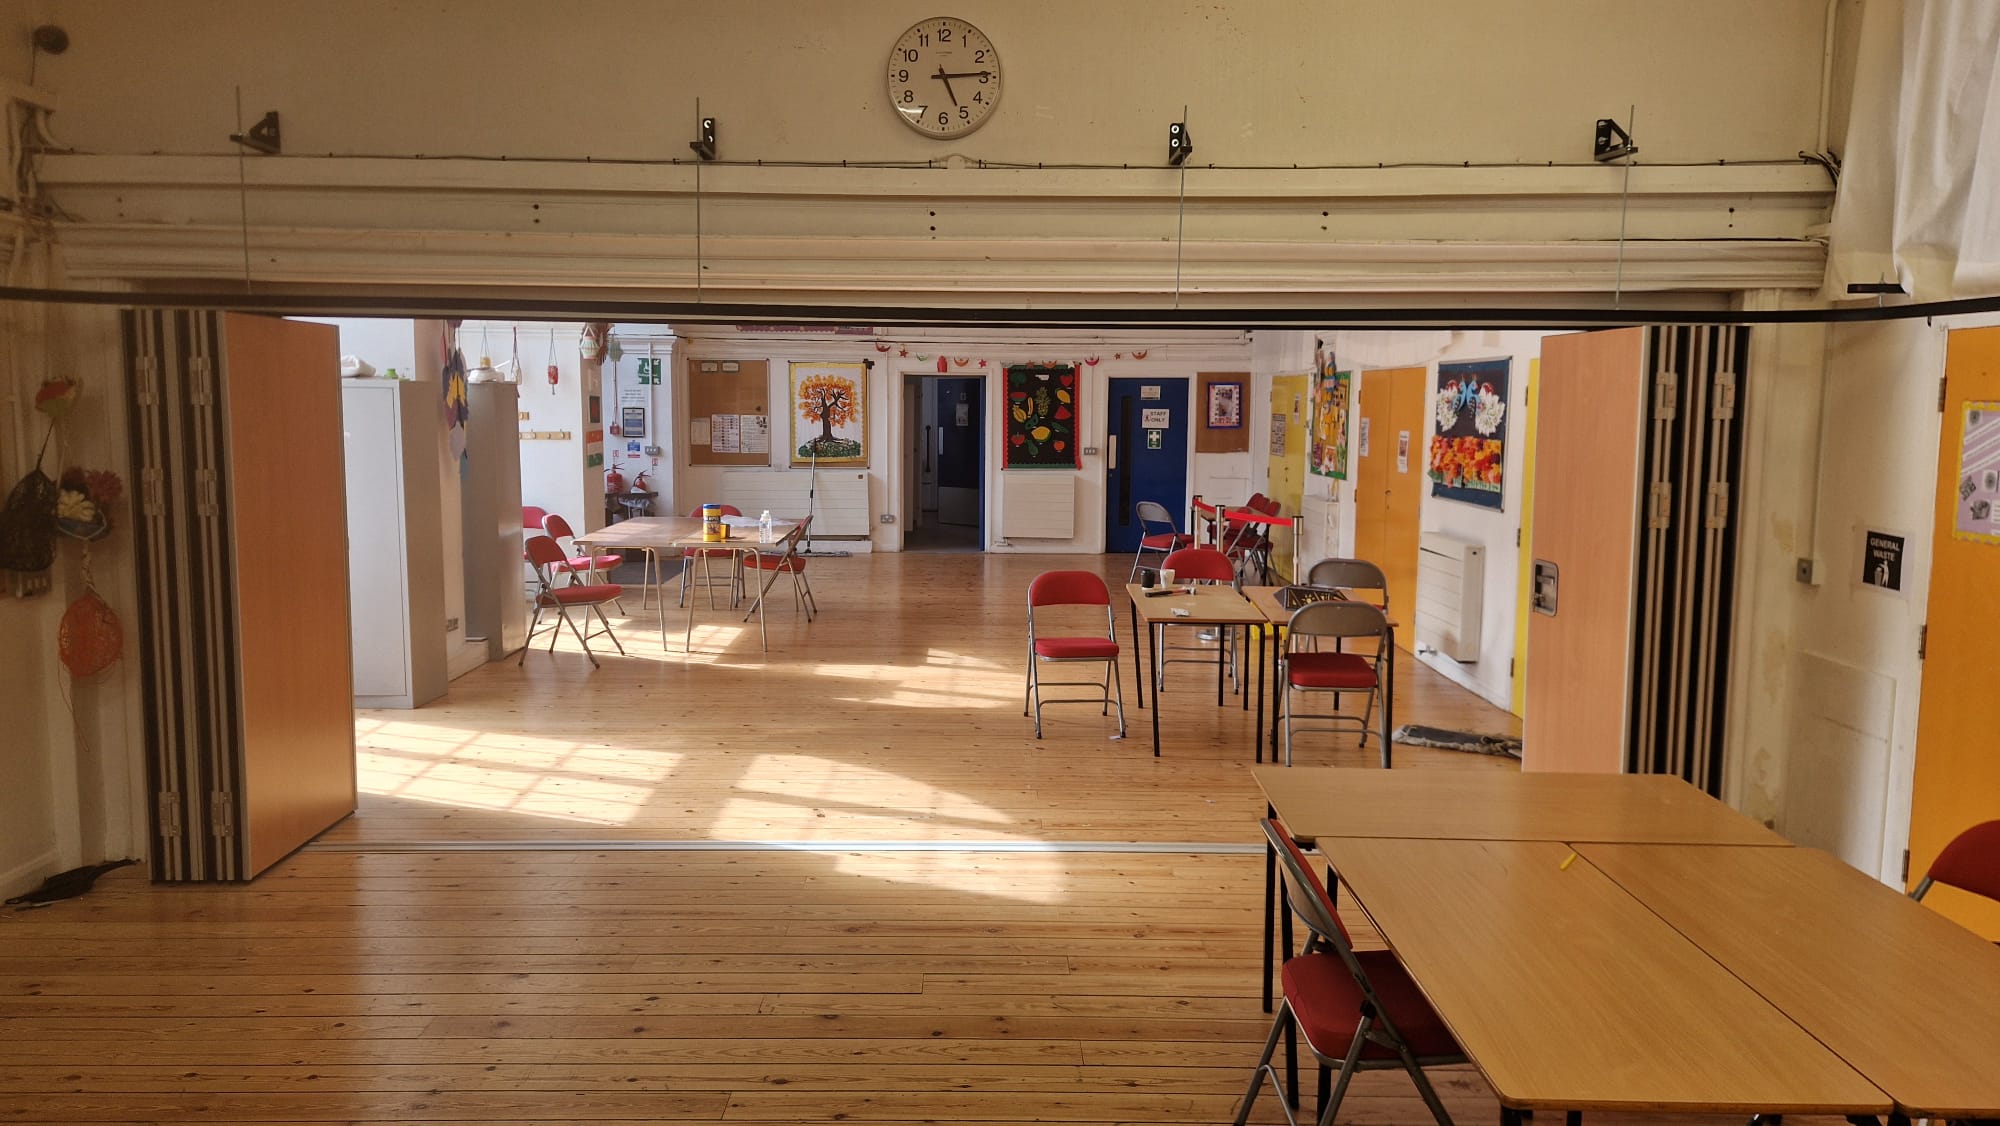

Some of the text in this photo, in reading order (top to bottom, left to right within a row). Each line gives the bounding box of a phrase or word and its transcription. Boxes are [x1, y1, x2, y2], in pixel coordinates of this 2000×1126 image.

[919, 34, 929, 47] 11
[937, 29, 952, 42] 12
[962, 35, 967, 48] 1
[903, 49, 919, 63] 10
[974, 50, 985, 63] 2
[898, 69, 909, 83] 9
[979, 71, 989, 84] 3
[903, 90, 914, 103] 8
[973, 91, 983, 104] 4
[918, 105, 928, 119] 7
[938, 112, 949, 125] 6
[959, 106, 969, 119] 5
[1870, 537, 1901, 551] GENERAL
[1873, 549, 1896, 562] WASTE
